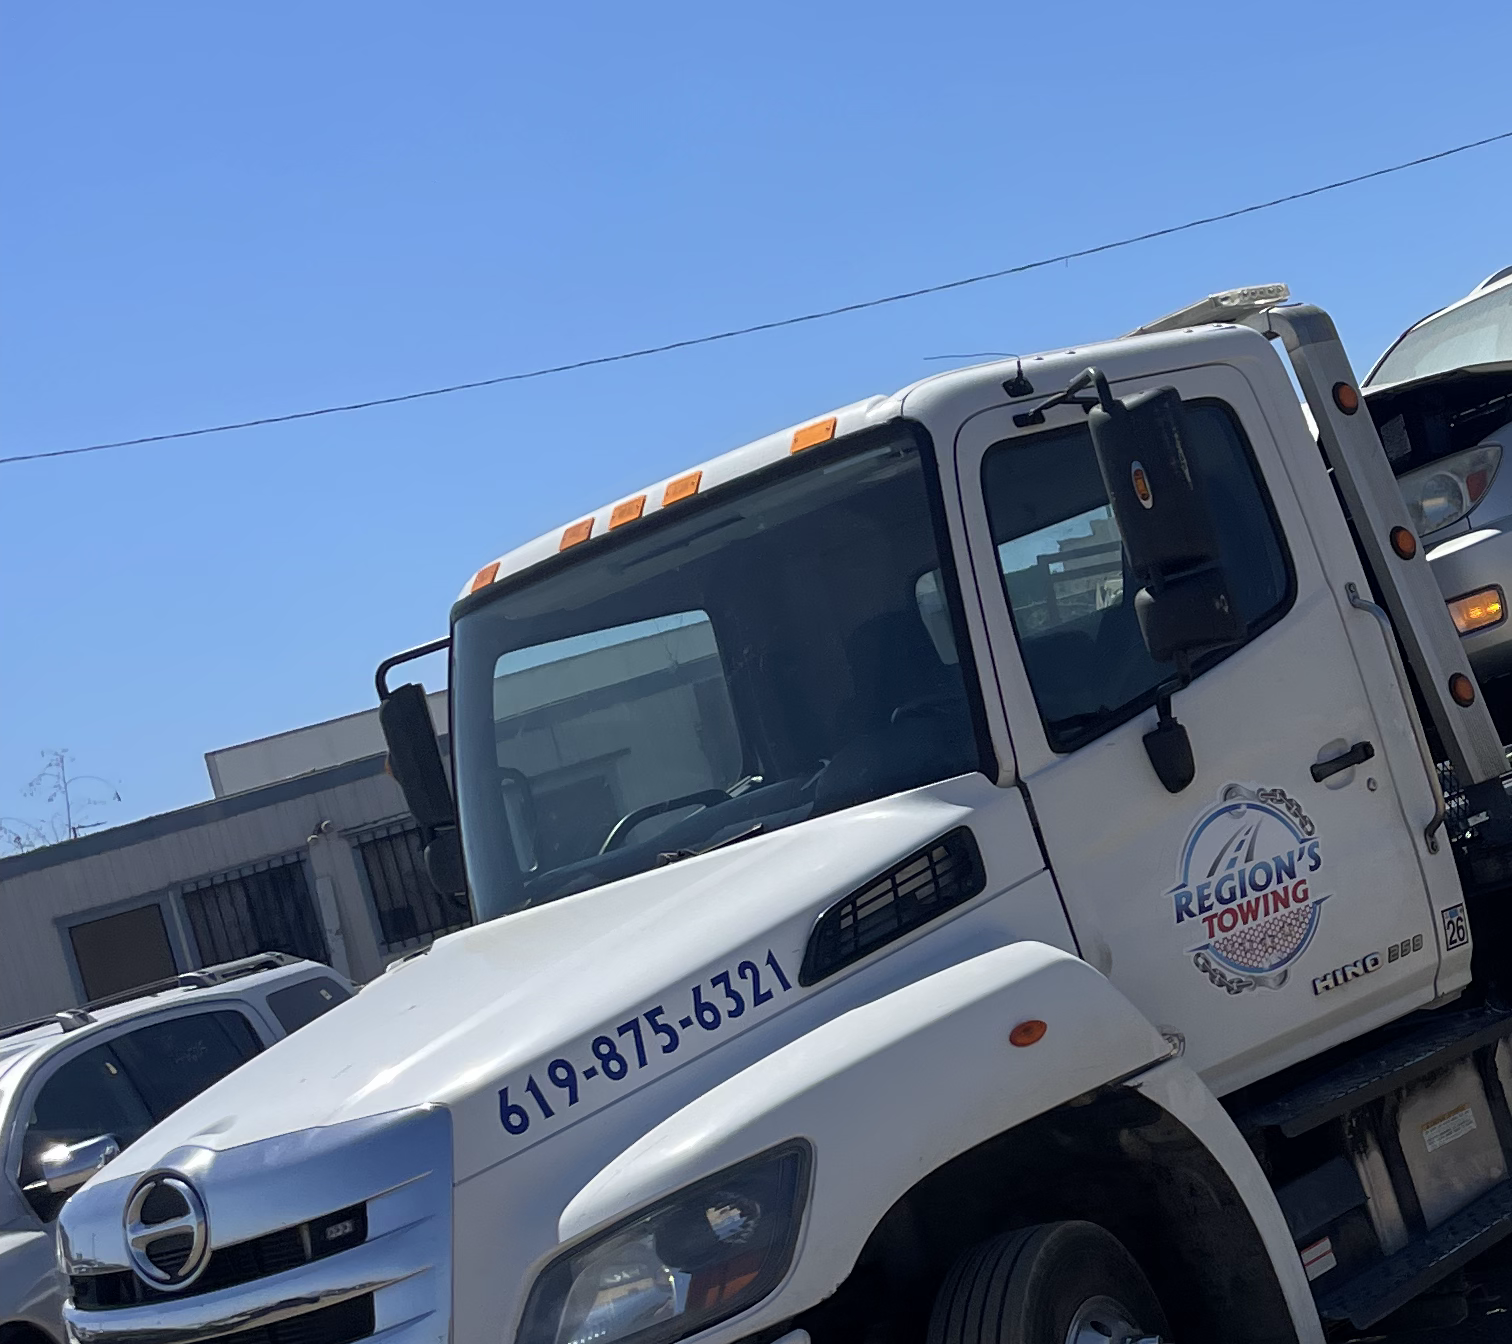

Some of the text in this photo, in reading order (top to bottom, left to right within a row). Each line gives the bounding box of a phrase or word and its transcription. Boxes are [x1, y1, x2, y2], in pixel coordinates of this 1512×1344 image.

[1173, 840, 1322, 924] REGION'S
[1201, 878, 1309, 940] TOWING
[1446, 915, 1466, 946] 26
[1312, 951, 1385, 996] HINO
[497, 948, 793, 1136] 619-875-6321
